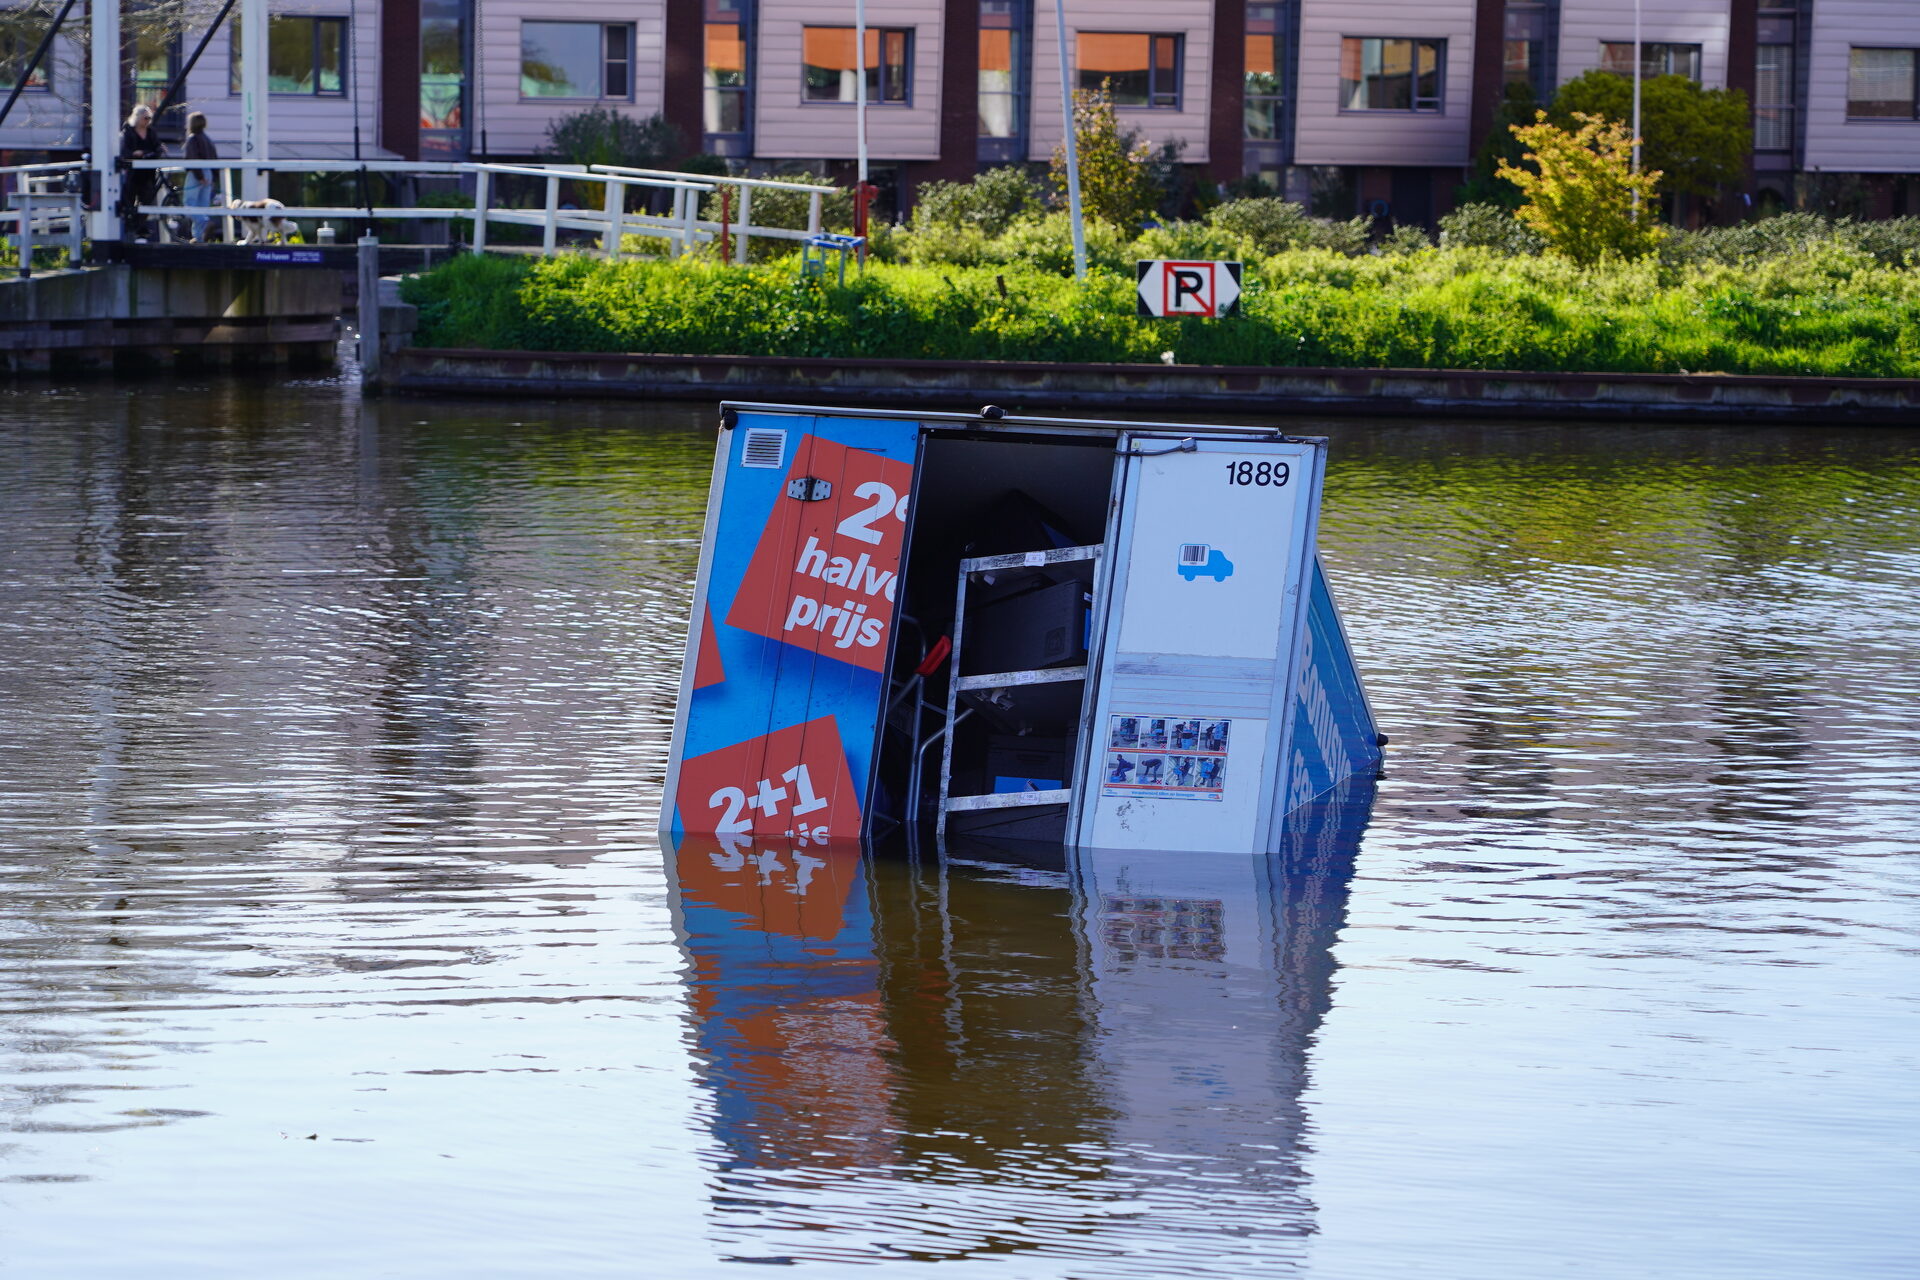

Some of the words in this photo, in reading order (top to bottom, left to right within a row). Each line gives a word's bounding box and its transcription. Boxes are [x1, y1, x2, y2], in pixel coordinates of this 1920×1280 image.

[1175, 271, 1203, 307] P
[1226, 460, 1290, 487] 1889
[784, 594, 885, 649] prijs
[709, 764, 828, 834] 2+1
